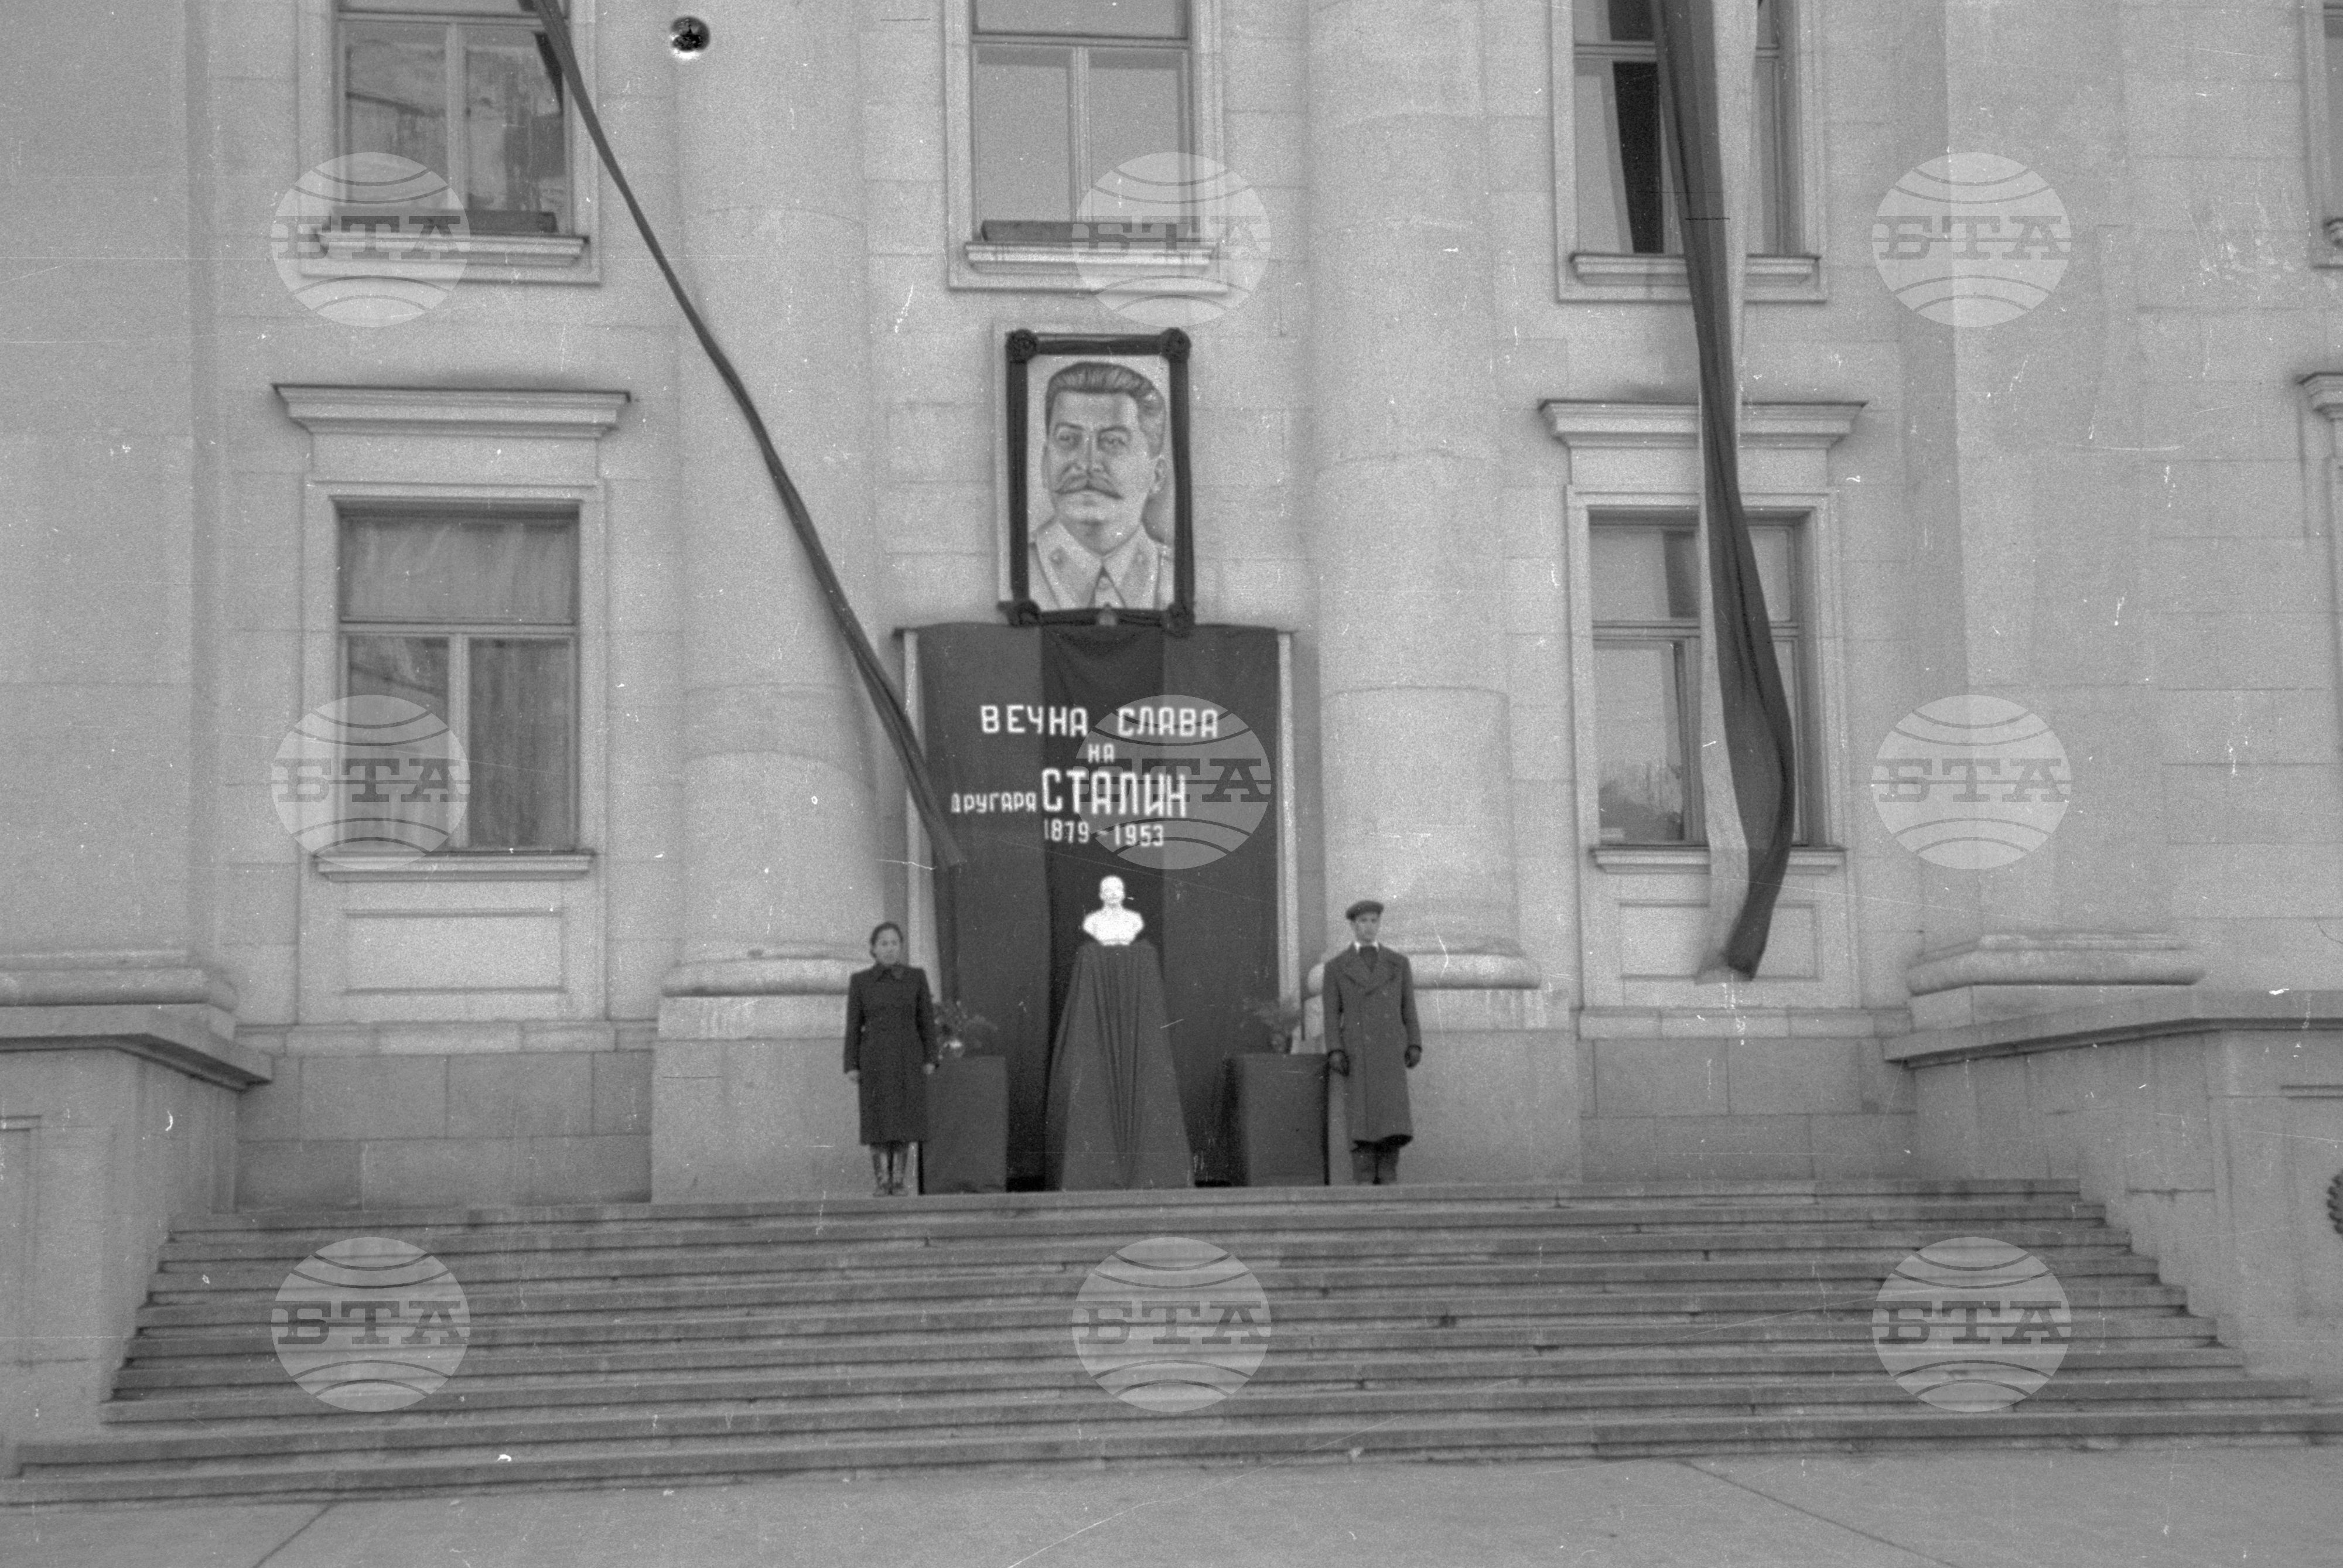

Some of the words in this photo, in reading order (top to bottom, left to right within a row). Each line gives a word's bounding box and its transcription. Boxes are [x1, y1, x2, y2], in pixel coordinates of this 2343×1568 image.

[979, 704, 1089, 737] ВЕЧНА
[1117, 706, 1218, 739] СЛАВА
[1041, 768, 1186, 818] СТАЛИН
